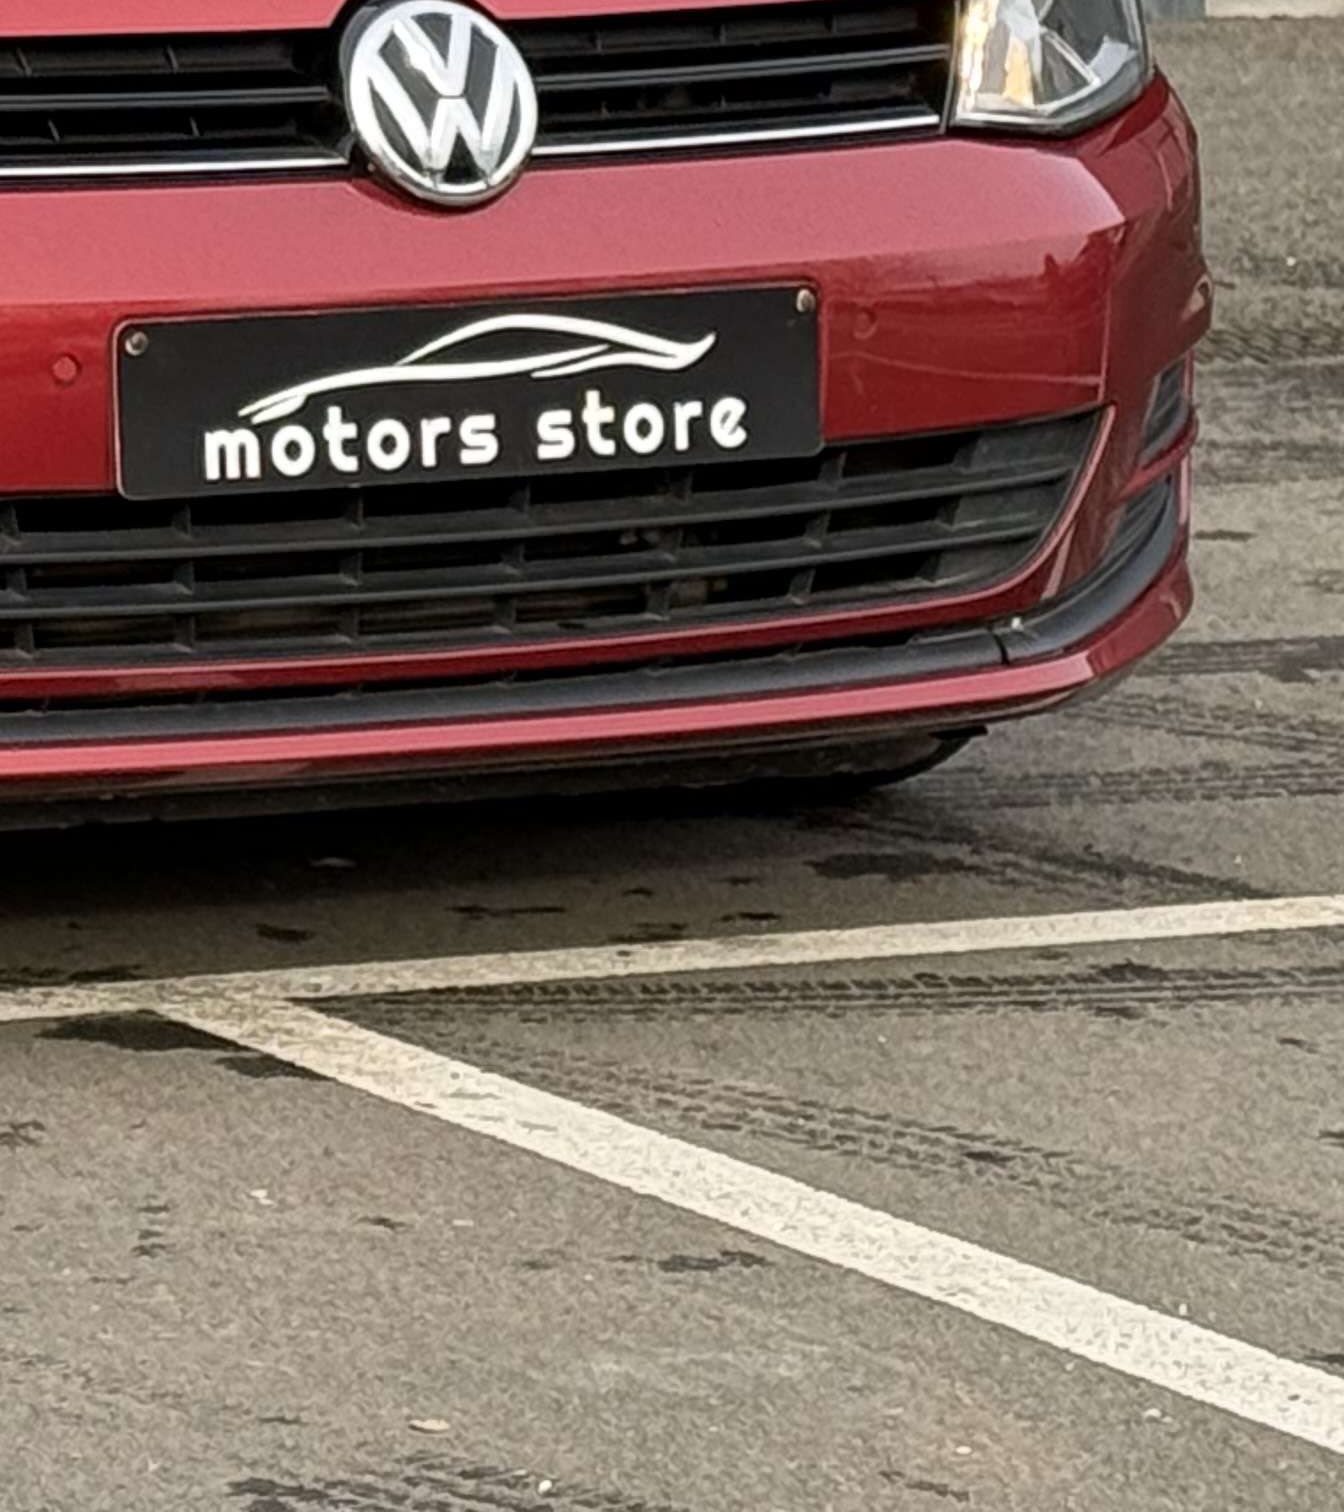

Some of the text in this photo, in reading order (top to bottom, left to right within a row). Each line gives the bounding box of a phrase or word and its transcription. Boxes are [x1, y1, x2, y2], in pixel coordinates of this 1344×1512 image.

[356, 4, 528, 188] VW
[203, 389, 749, 481] motors store
